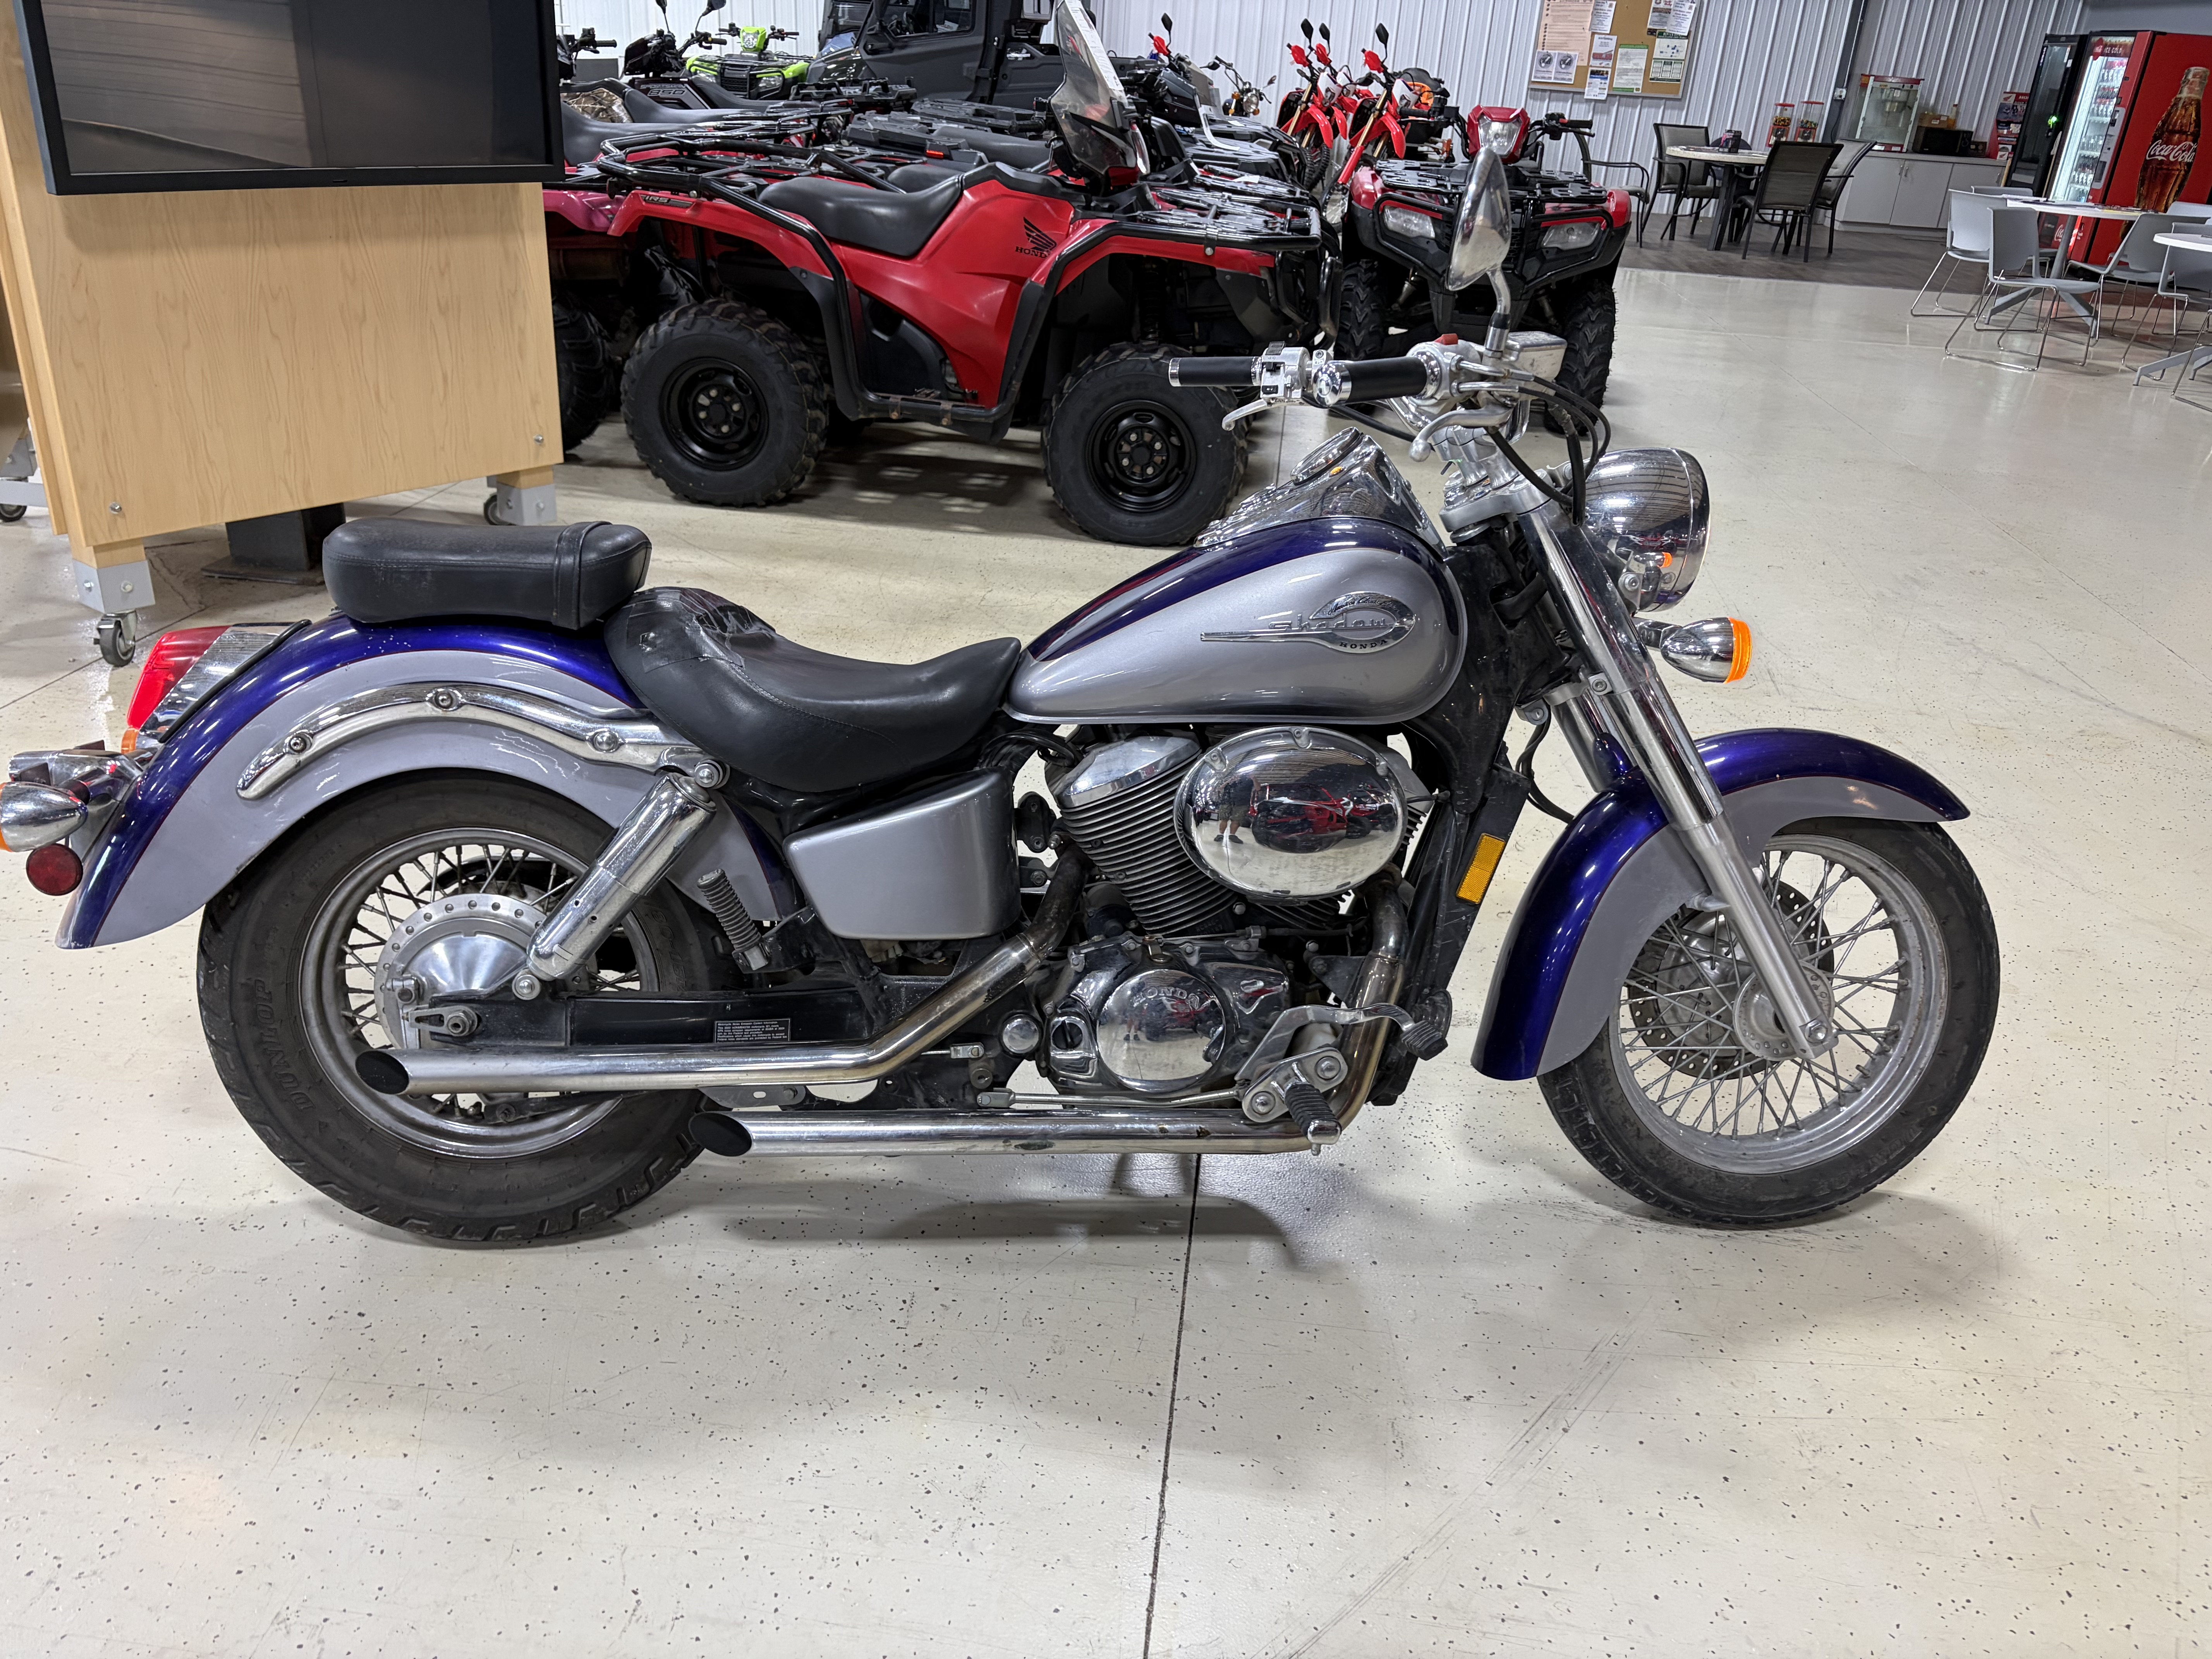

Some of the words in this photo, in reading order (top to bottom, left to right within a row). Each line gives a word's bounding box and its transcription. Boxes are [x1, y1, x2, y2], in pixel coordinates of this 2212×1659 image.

[2146, 139, 2198, 163] Coca-Cola
[1268, 614, 1386, 631] Shadow
[1339, 639, 1388, 649] HONDA
[1130, 986, 1200, 1011] HONDA
[252, 978, 316, 1115] DUNLOP
